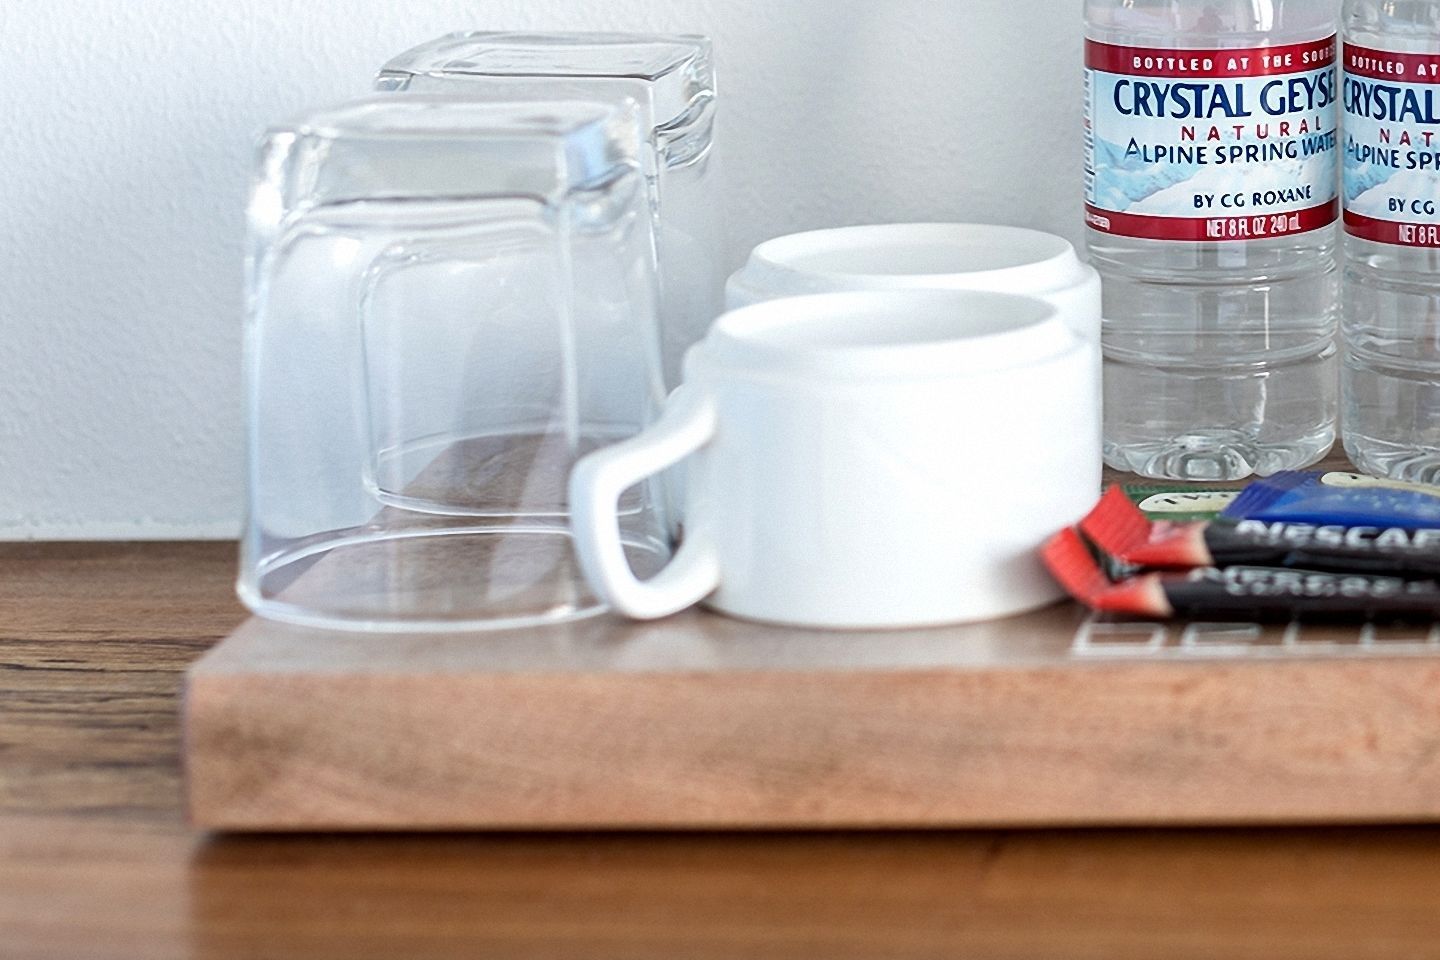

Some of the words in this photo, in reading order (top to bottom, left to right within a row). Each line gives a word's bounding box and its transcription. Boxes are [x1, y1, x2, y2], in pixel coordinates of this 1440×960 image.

[1133, 56, 1213, 71] BOTTLED
[1227, 57, 1249, 70] AT
[1262, 54, 1292, 68] THE
[1351, 55, 1405, 75] BOTTLED
[1417, 63, 1439, 77] AT
[1114, 79, 1252, 119] CRYSTAL
[1259, 68, 1336, 116] GEYSE
[1181, 116, 1321, 141] NATURAL
[1123, 136, 1208, 165] ALPINE
[1215, 140, 1298, 165] SPRING
[1302, 128, 1336, 157] WATE
[1347, 134, 1400, 169] ALPINE
[1193, 194, 1215, 208] BY
[1221, 194, 1246, 208] CG
[1252, 185, 1312, 206] ROXANE
[1388, 197, 1406, 213] BY
[1411, 200, 1435, 215] CG
[1206, 218, 1228, 238] NET
[1228, 218, 1238, 237] 8
[1253, 216, 1267, 235] OZ
[1270, 214, 1288, 234] 240
[1399, 225, 1416, 244] NET
[1418, 226, 1427, 244] 8
